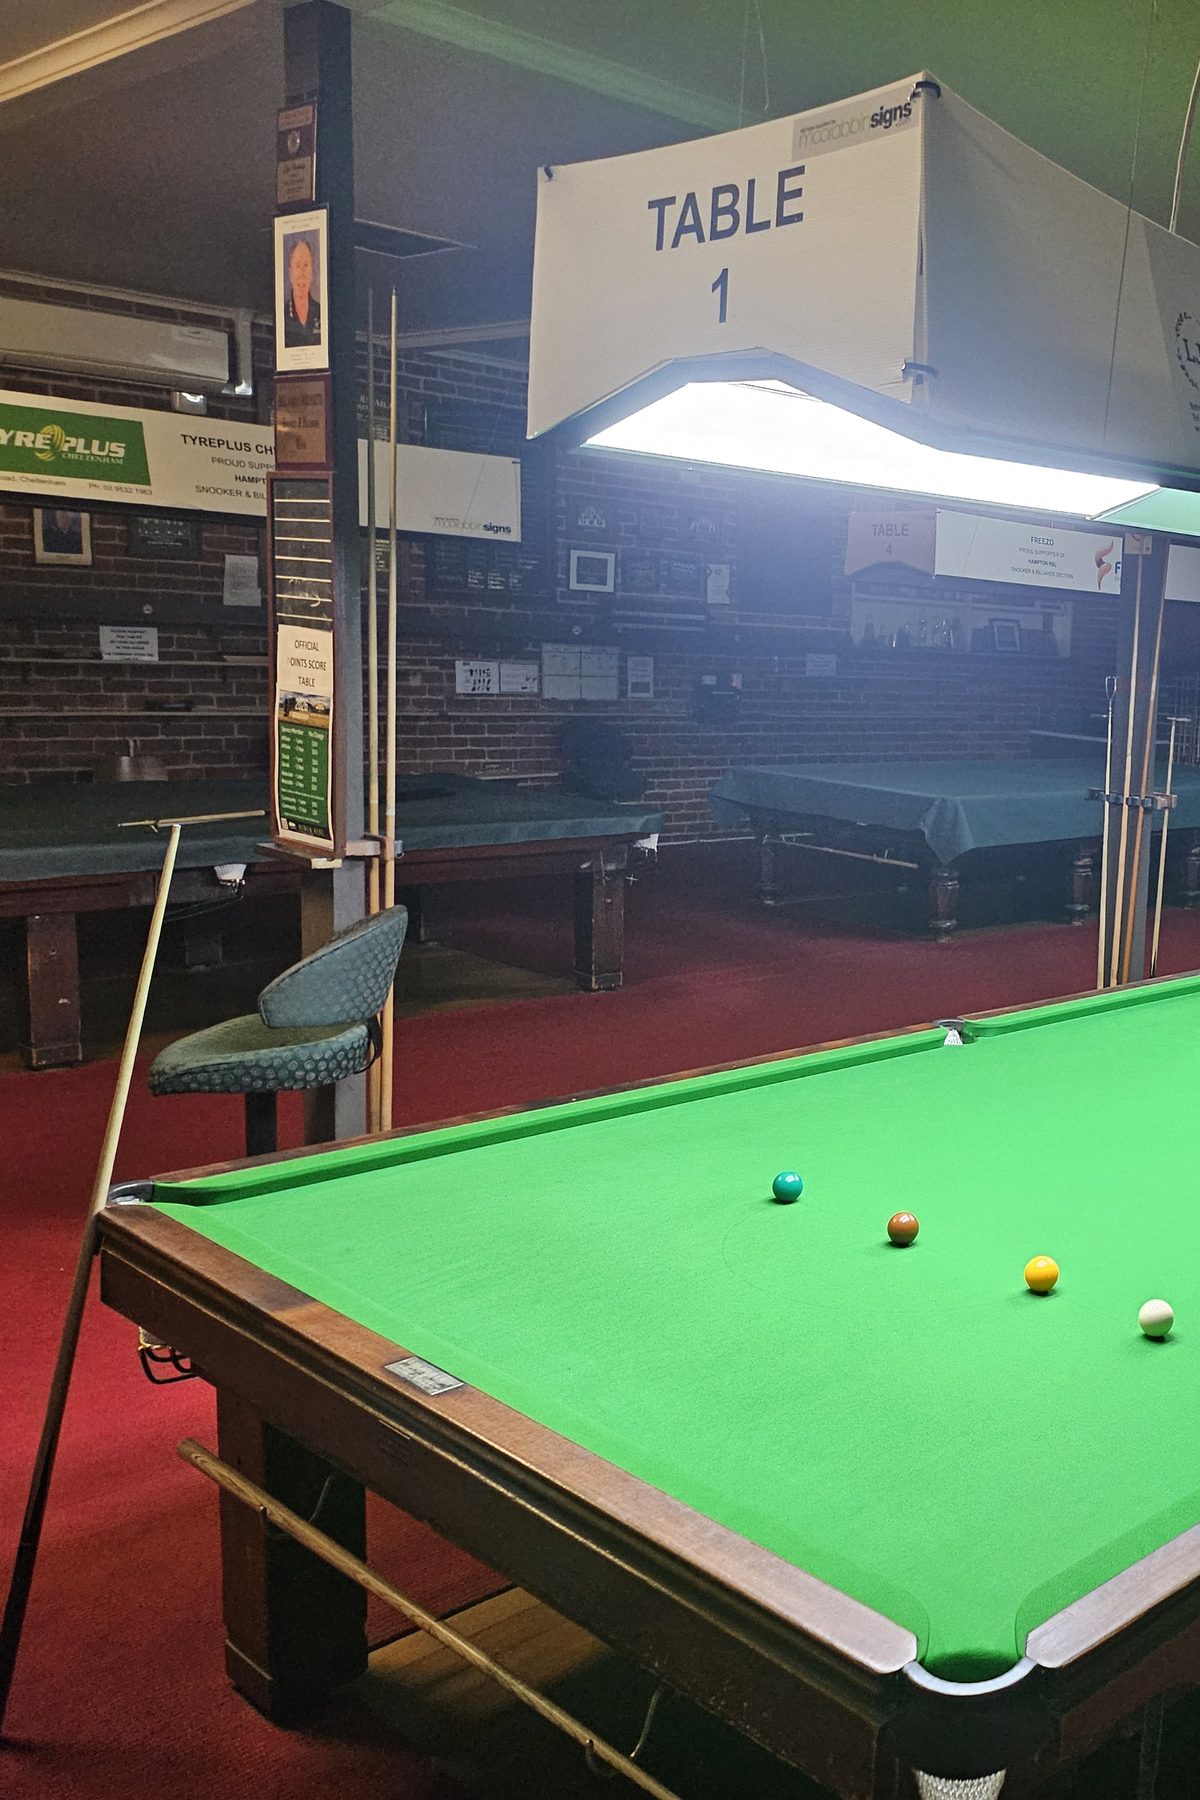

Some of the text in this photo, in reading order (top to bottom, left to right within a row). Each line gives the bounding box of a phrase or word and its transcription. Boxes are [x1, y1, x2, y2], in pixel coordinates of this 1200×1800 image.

[648, 165, 806, 251] TABLE
[711, 268, 730, 323] 1
[180, 433, 276, 455] TYREPLUS CH
[61, 452, 124, 465] CHELTENHAM
[210, 456, 246, 468] PROUD
[194, 484, 242, 497] SNOOKER
[244, 490, 251, 498] &
[871, 523, 910, 537] TABLE
[1030, 536, 1055, 546] FREEZO
[885, 542, 893, 555] 4
[294, 639, 320, 652] OFFICIAL
[287, 656, 327, 671] OINTS SCORE
[298, 676, 316, 688] TABLE
